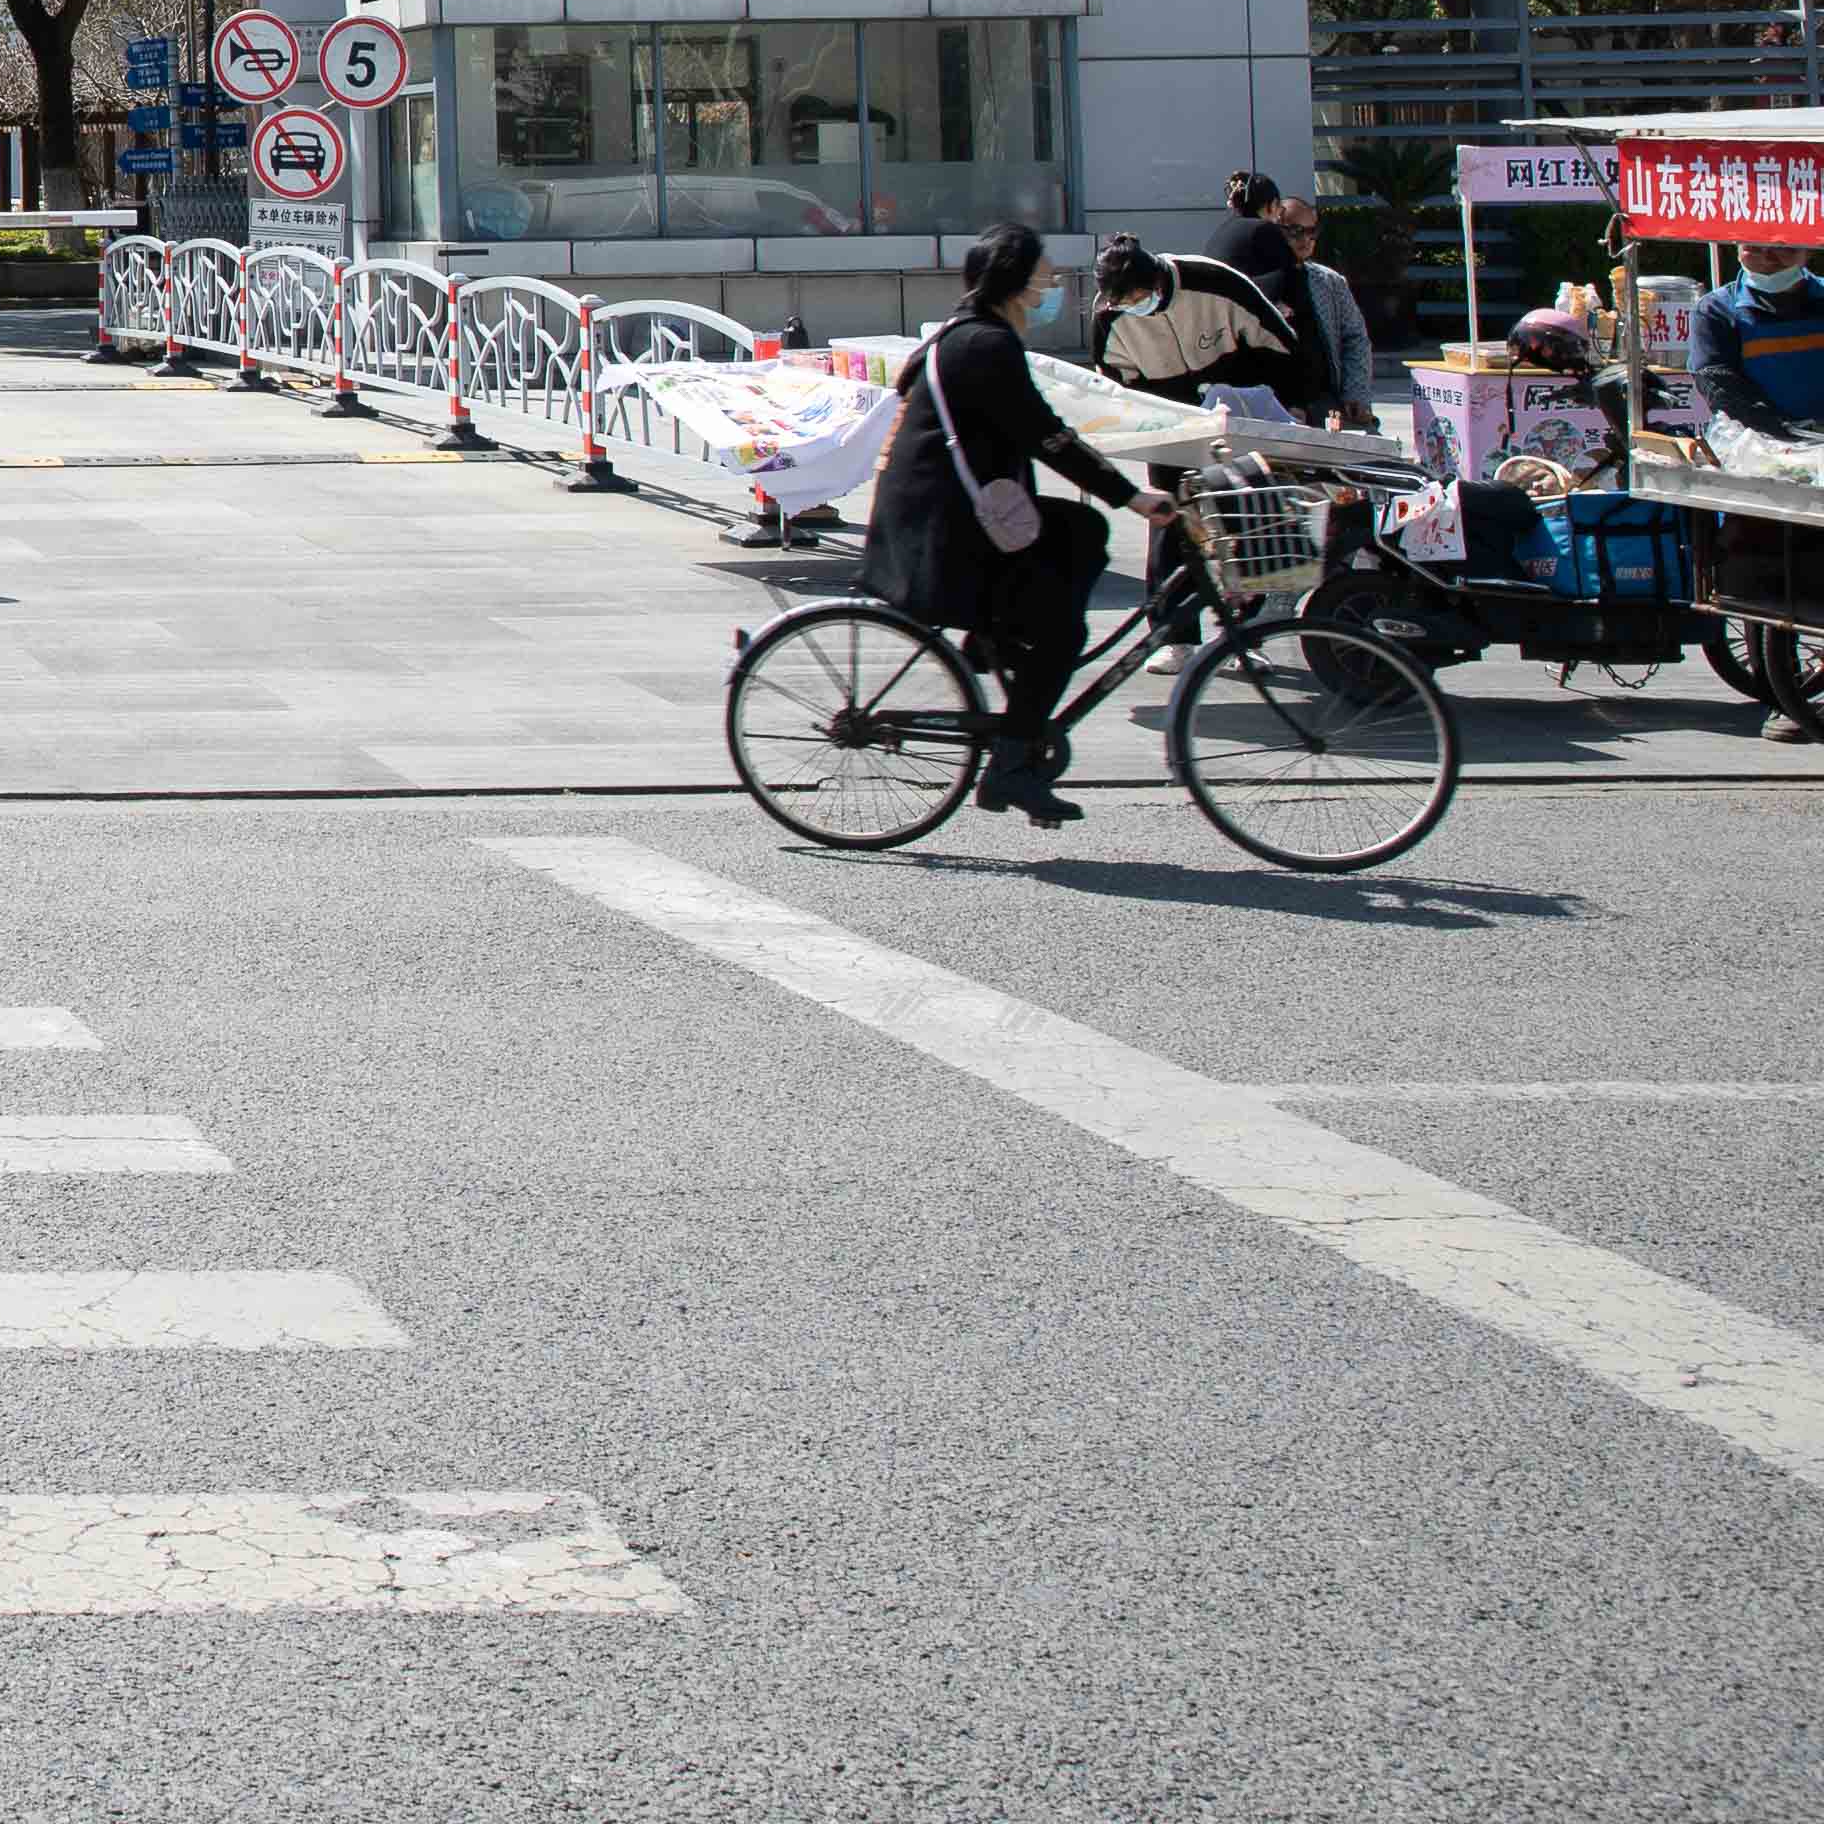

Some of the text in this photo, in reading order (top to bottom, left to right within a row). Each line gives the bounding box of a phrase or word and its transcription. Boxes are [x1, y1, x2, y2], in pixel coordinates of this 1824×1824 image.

[344, 40, 377, 88] 5
[1626, 154, 1824, 225] 山东杂粮煎饼
[257, 207, 340, 227] 本单位车辆除外
